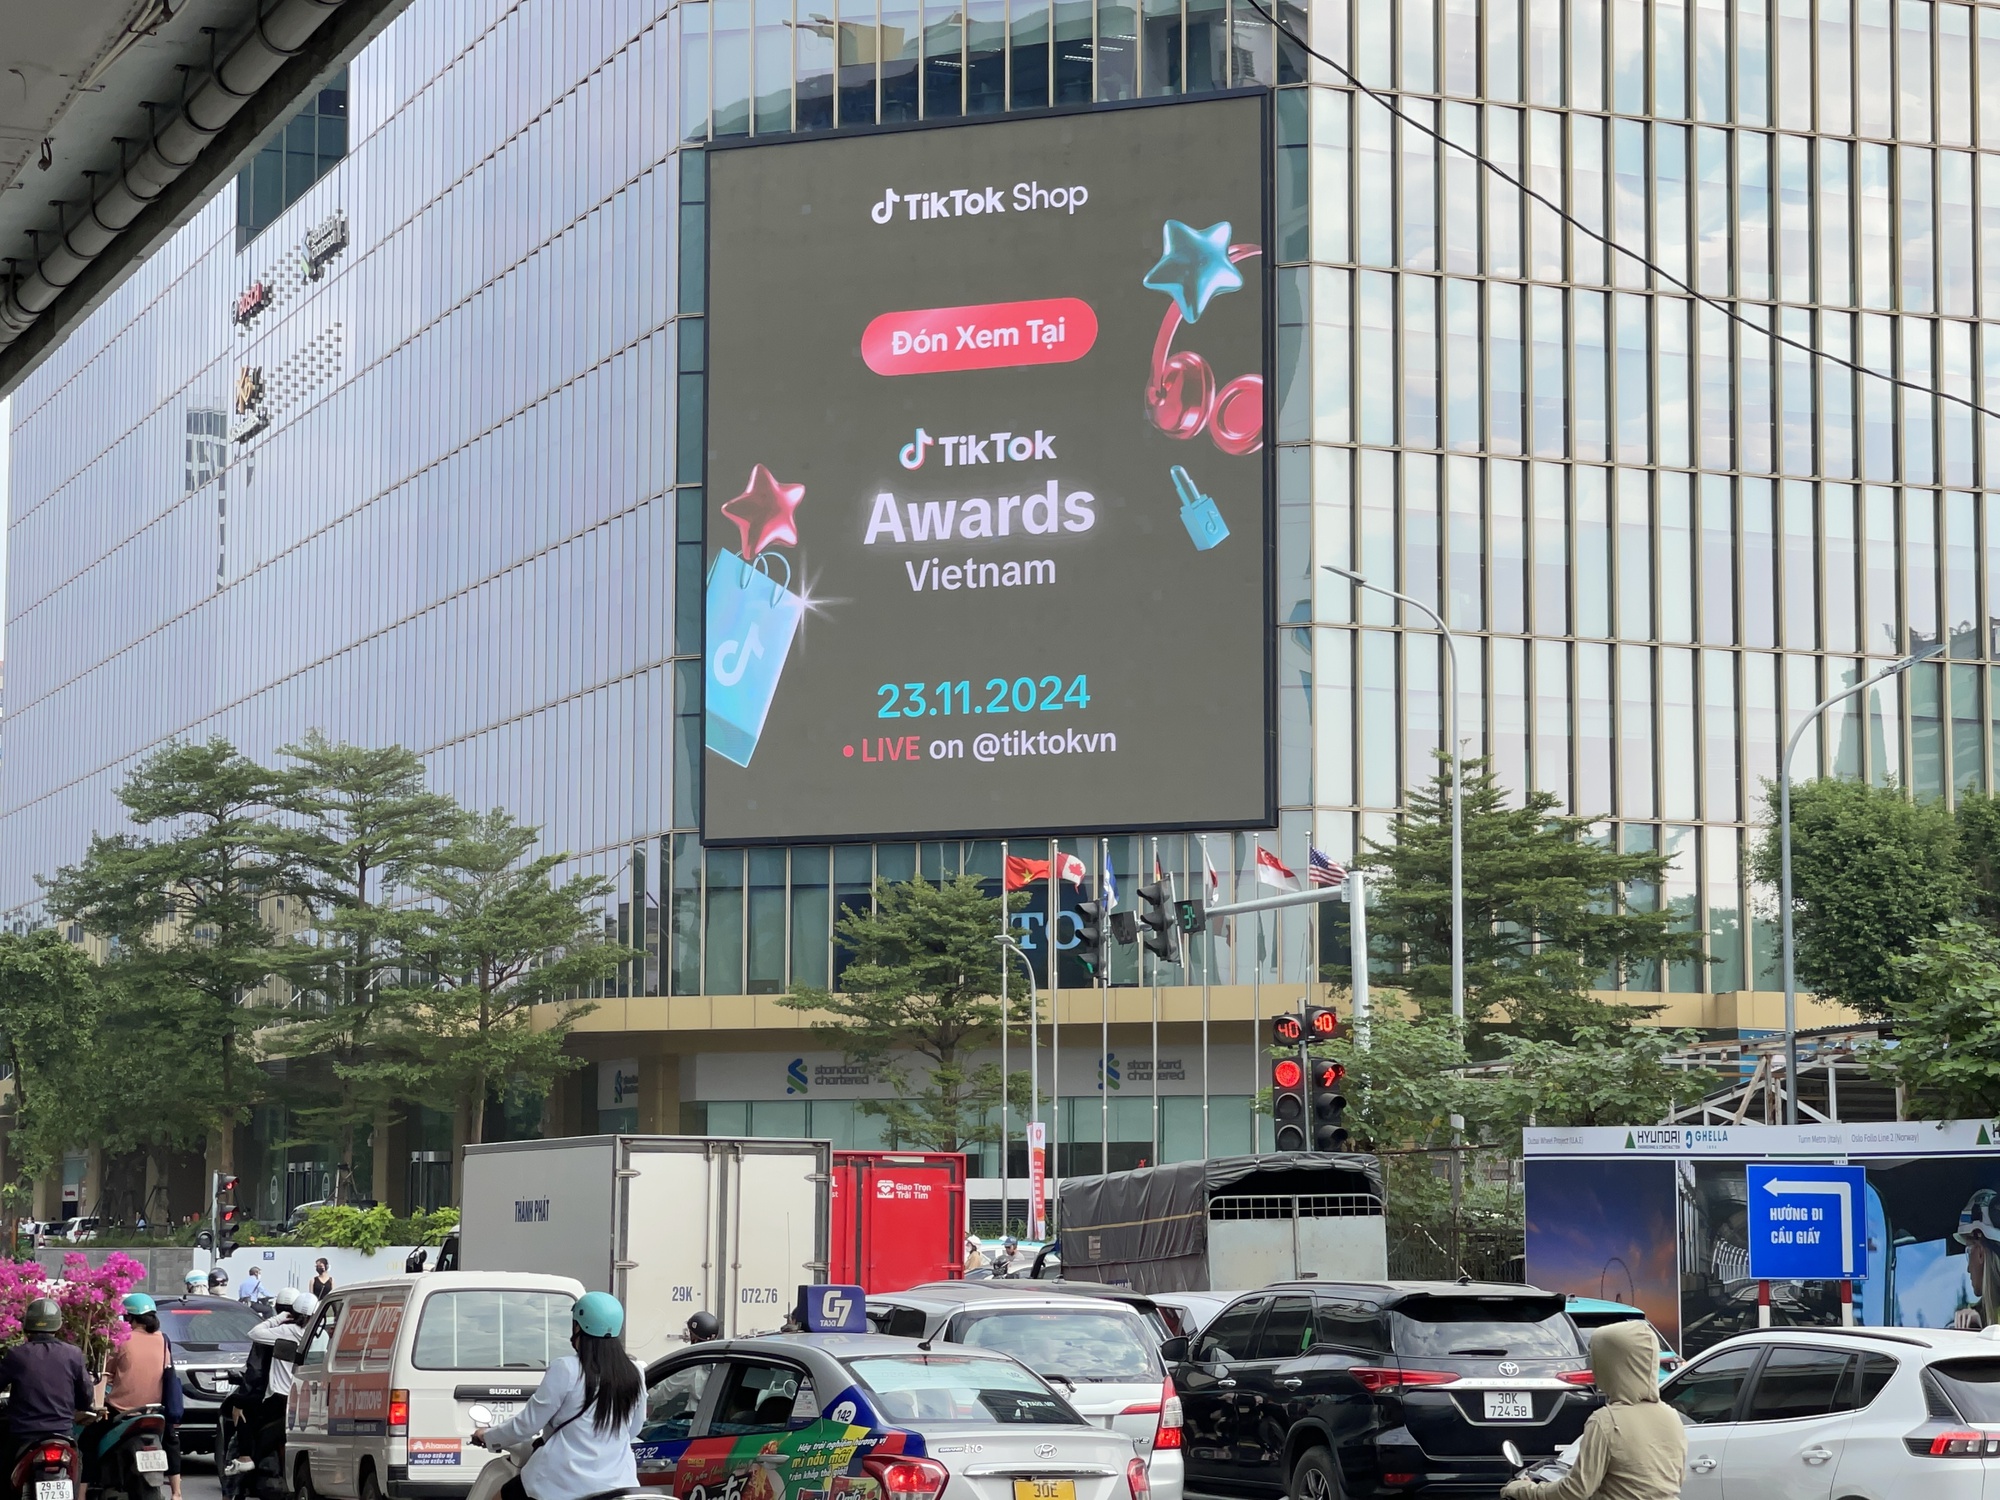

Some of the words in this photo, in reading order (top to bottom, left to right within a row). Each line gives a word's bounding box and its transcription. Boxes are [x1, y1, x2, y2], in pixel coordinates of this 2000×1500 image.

[904, 187, 1006, 220] TikTok
[1012, 181, 1089, 215] Shop
[892, 328, 948, 356] Đón
[955, 325, 1019, 351] Xem
[1026, 316, 1066, 350] Tại
[938, 429, 1057, 467] TikTok
[863, 480, 1096, 545] Awards
[905, 558, 1056, 592] Vietnam
[877, 674, 1091, 718] 23.11.2024
[861, 735, 921, 762] LIVE
[929, 738, 964, 760] on
[972, 728, 1117, 762] @tiktokvn
[1278, 1021, 1299, 1038] 40
[1314, 1013, 1333, 1033] 40
[815, 1075, 869, 1085] chartered
[1637, 1130, 1681, 1144] HYUNDAI
[1695, 1130, 1729, 1142] GHELLA
[1811, 1134, 1827, 1144] Metro
[1851, 1134, 1864, 1143] Oslo
[1877, 1133, 1889, 1142] Line
[1895, 1132, 1920, 1143] (Norway)
[895, 1183, 912, 1191] Giao
[914, 1191, 929, 1200] Tim
[1769, 1203, 1809, 1221] HƯỚNG
[1811, 1207, 1824, 1221] ĐI
[1770, 1226, 1793, 1244] CẦU
[1796, 1226, 1821, 1244] GIẤY
[741, 1288, 778, 1304] 072.76
[1498, 1393, 1518, 1405] 30K
[491, 1401, 514, 1413] 29D
[1490, 1405, 1528, 1417] 724.58
[836, 1408, 851, 1422] 142
[425, 1442, 459, 1450] Ahamove
[39, 1490, 71, 1500] 172.99
[1034, 1483, 1059, 1498] 30E
